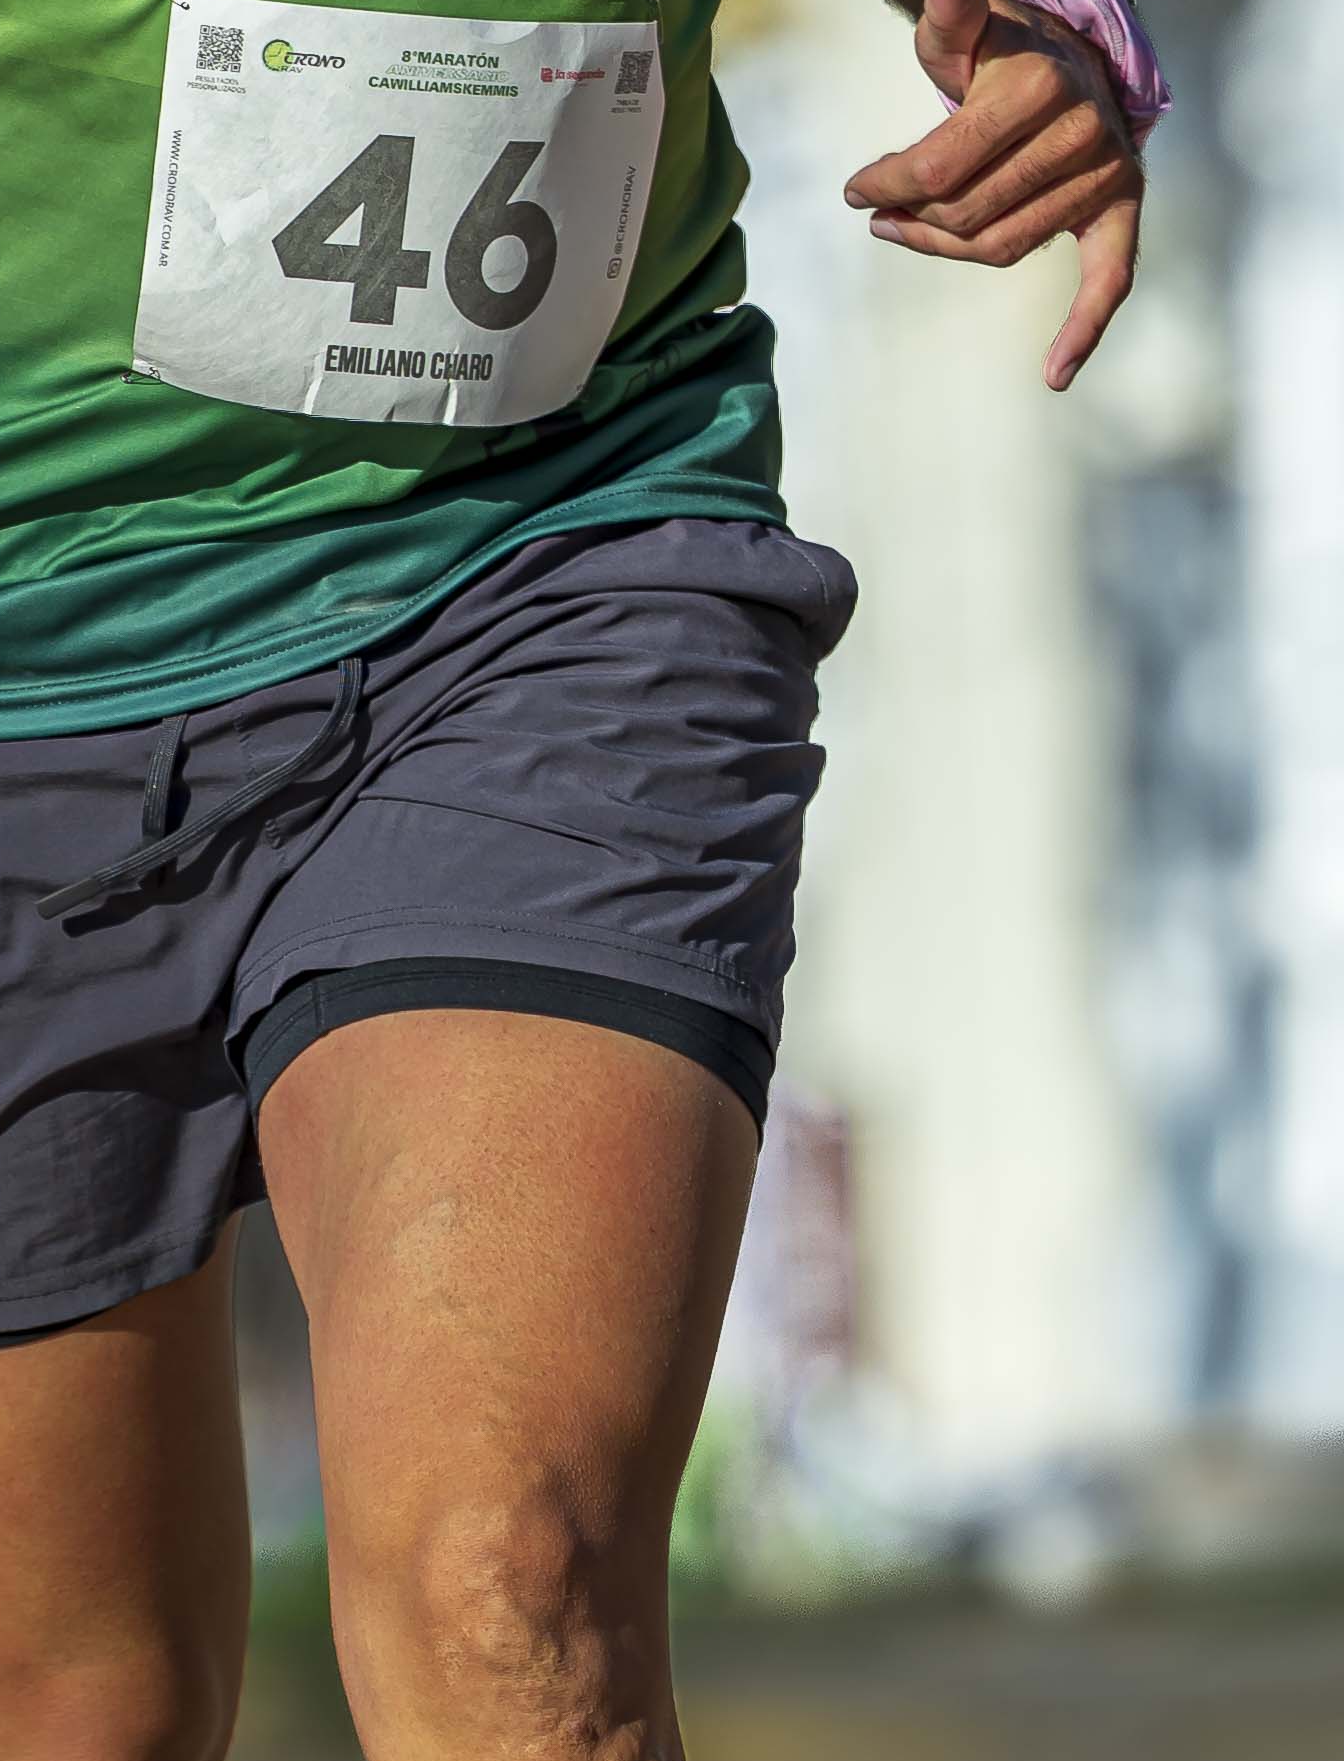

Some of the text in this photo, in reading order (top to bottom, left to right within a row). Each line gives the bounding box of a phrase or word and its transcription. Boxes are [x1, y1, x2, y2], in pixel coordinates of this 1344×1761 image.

[368, 76, 519, 97] CAWILLIAMSKEMMIS
[271, 133, 558, 331] 46
[324, 344, 426, 379] EMILIANO
